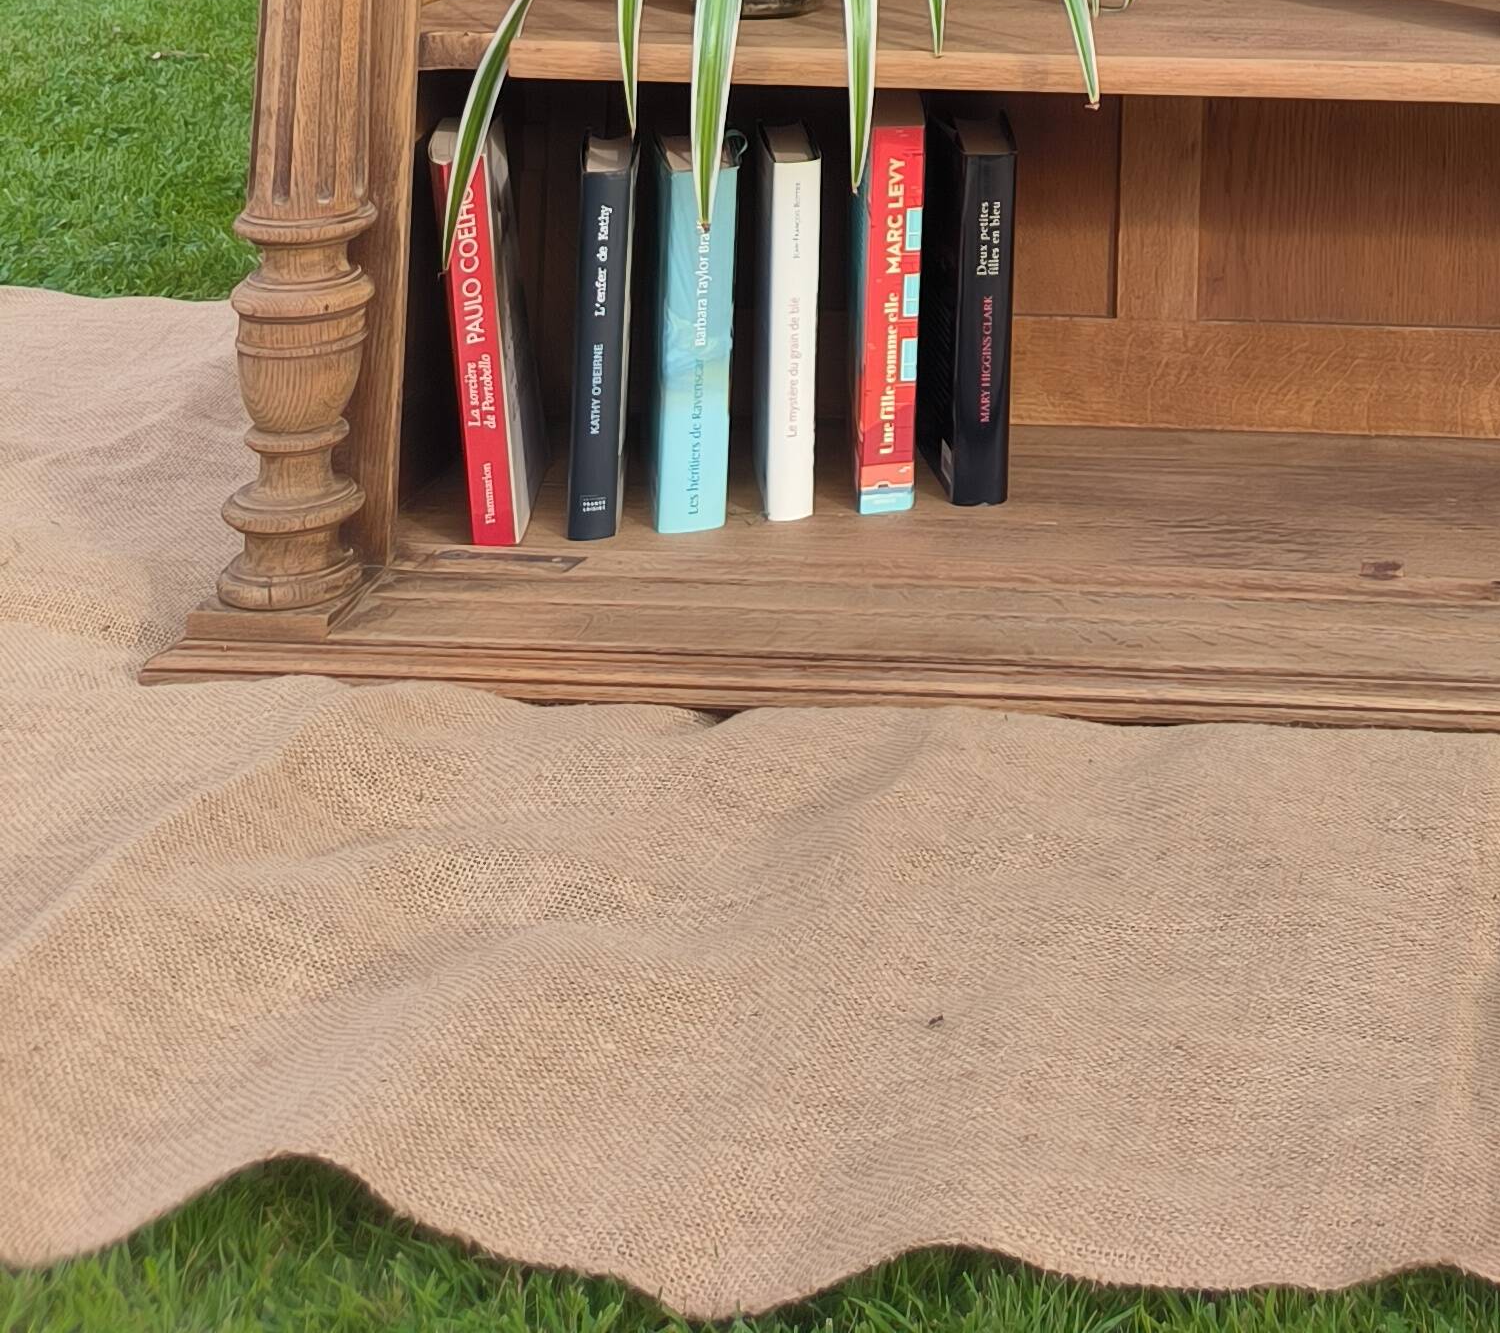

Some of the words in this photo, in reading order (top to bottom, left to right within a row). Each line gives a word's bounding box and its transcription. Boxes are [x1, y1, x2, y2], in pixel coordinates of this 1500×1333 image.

[887, 158, 907, 209] LEVY
[597, 204, 613, 241] Kathy
[978, 201, 991, 241] petites
[988, 200, 1001, 228] bleu
[596, 245, 607, 262] de
[885, 213, 904, 274] MARC
[991, 228, 1001, 244] en
[694, 257, 713, 297] Taylor
[976, 243, 989, 276] Deux
[987, 247, 1000, 276] filles
[594, 267, 607, 317] L'enfer
[883, 292, 899, 324] elle
[460, 277, 487, 345] PAULO
[694, 298, 708, 347] Barbara
[787, 315, 800, 332] de
[981, 295, 994, 335] CLARK
[787, 333, 802, 360] grain
[884, 324, 898, 384] comme
[980, 336, 993, 388] HIGGINS
[464, 361, 480, 407] sorcière
[478, 353, 496, 412] Portobello
[590, 343, 604, 396] O'BEIRNE
[787, 361, 800, 377] du
[690, 357, 705, 420] Ravenscar
[787, 378, 801, 423] mystère
[880, 384, 897, 421] fille
[979, 388, 992, 424] MARY
[467, 407, 481, 428] La
[482, 414, 497, 429] de
[589, 397, 602, 435] KATHY
[688, 422, 702, 440] de
[786, 424, 798, 439] Le
[879, 423, 896, 455] Une
[685, 441, 702, 493] héritiers
[480, 462, 496, 525] Flammarion
[686, 493, 699, 516] Les
